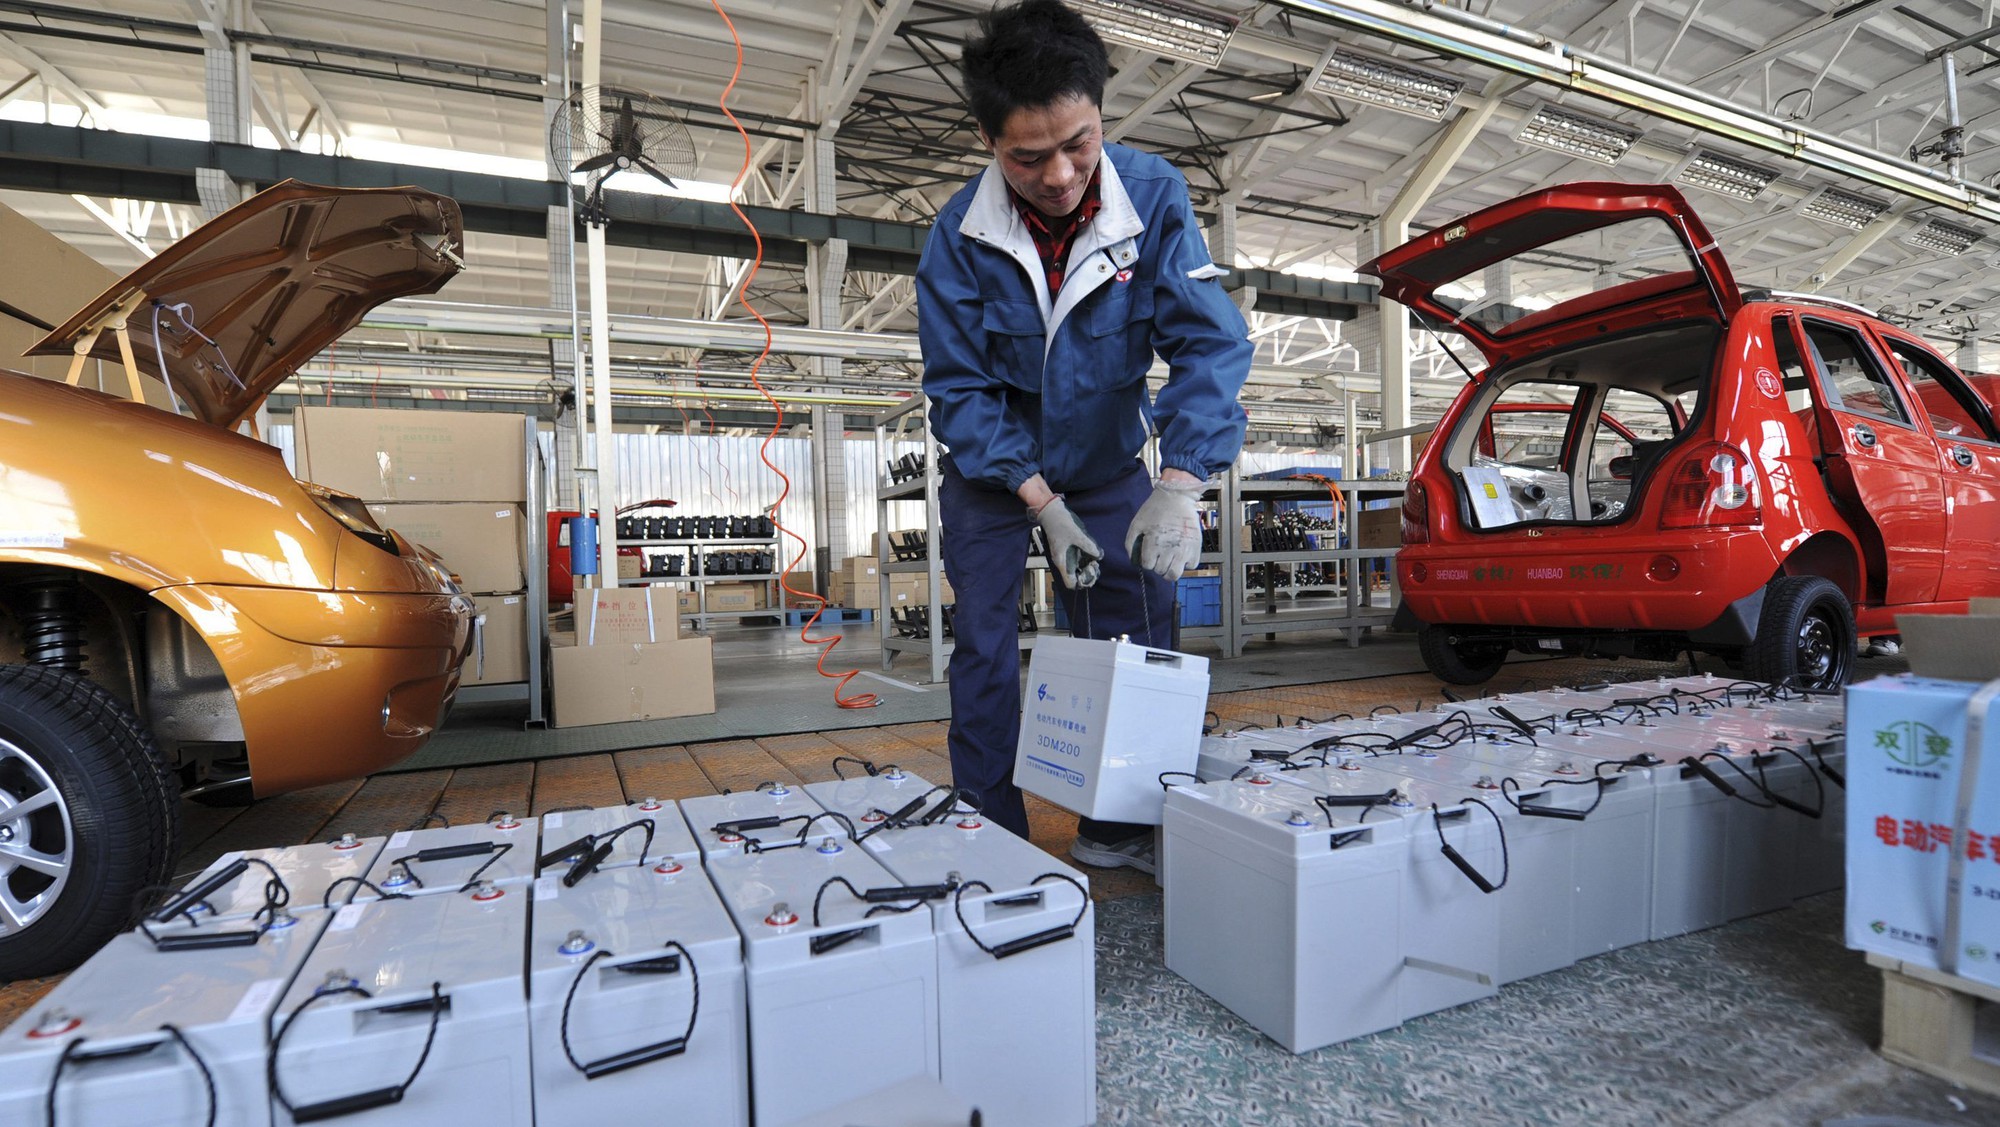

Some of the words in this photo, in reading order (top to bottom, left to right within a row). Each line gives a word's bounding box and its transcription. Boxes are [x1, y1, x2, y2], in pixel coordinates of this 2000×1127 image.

[1436, 569, 1468, 580] SHENGQIAN
[1527, 567, 1563, 579] HUANBAO
[1037, 734, 1080, 757] 3DM200
